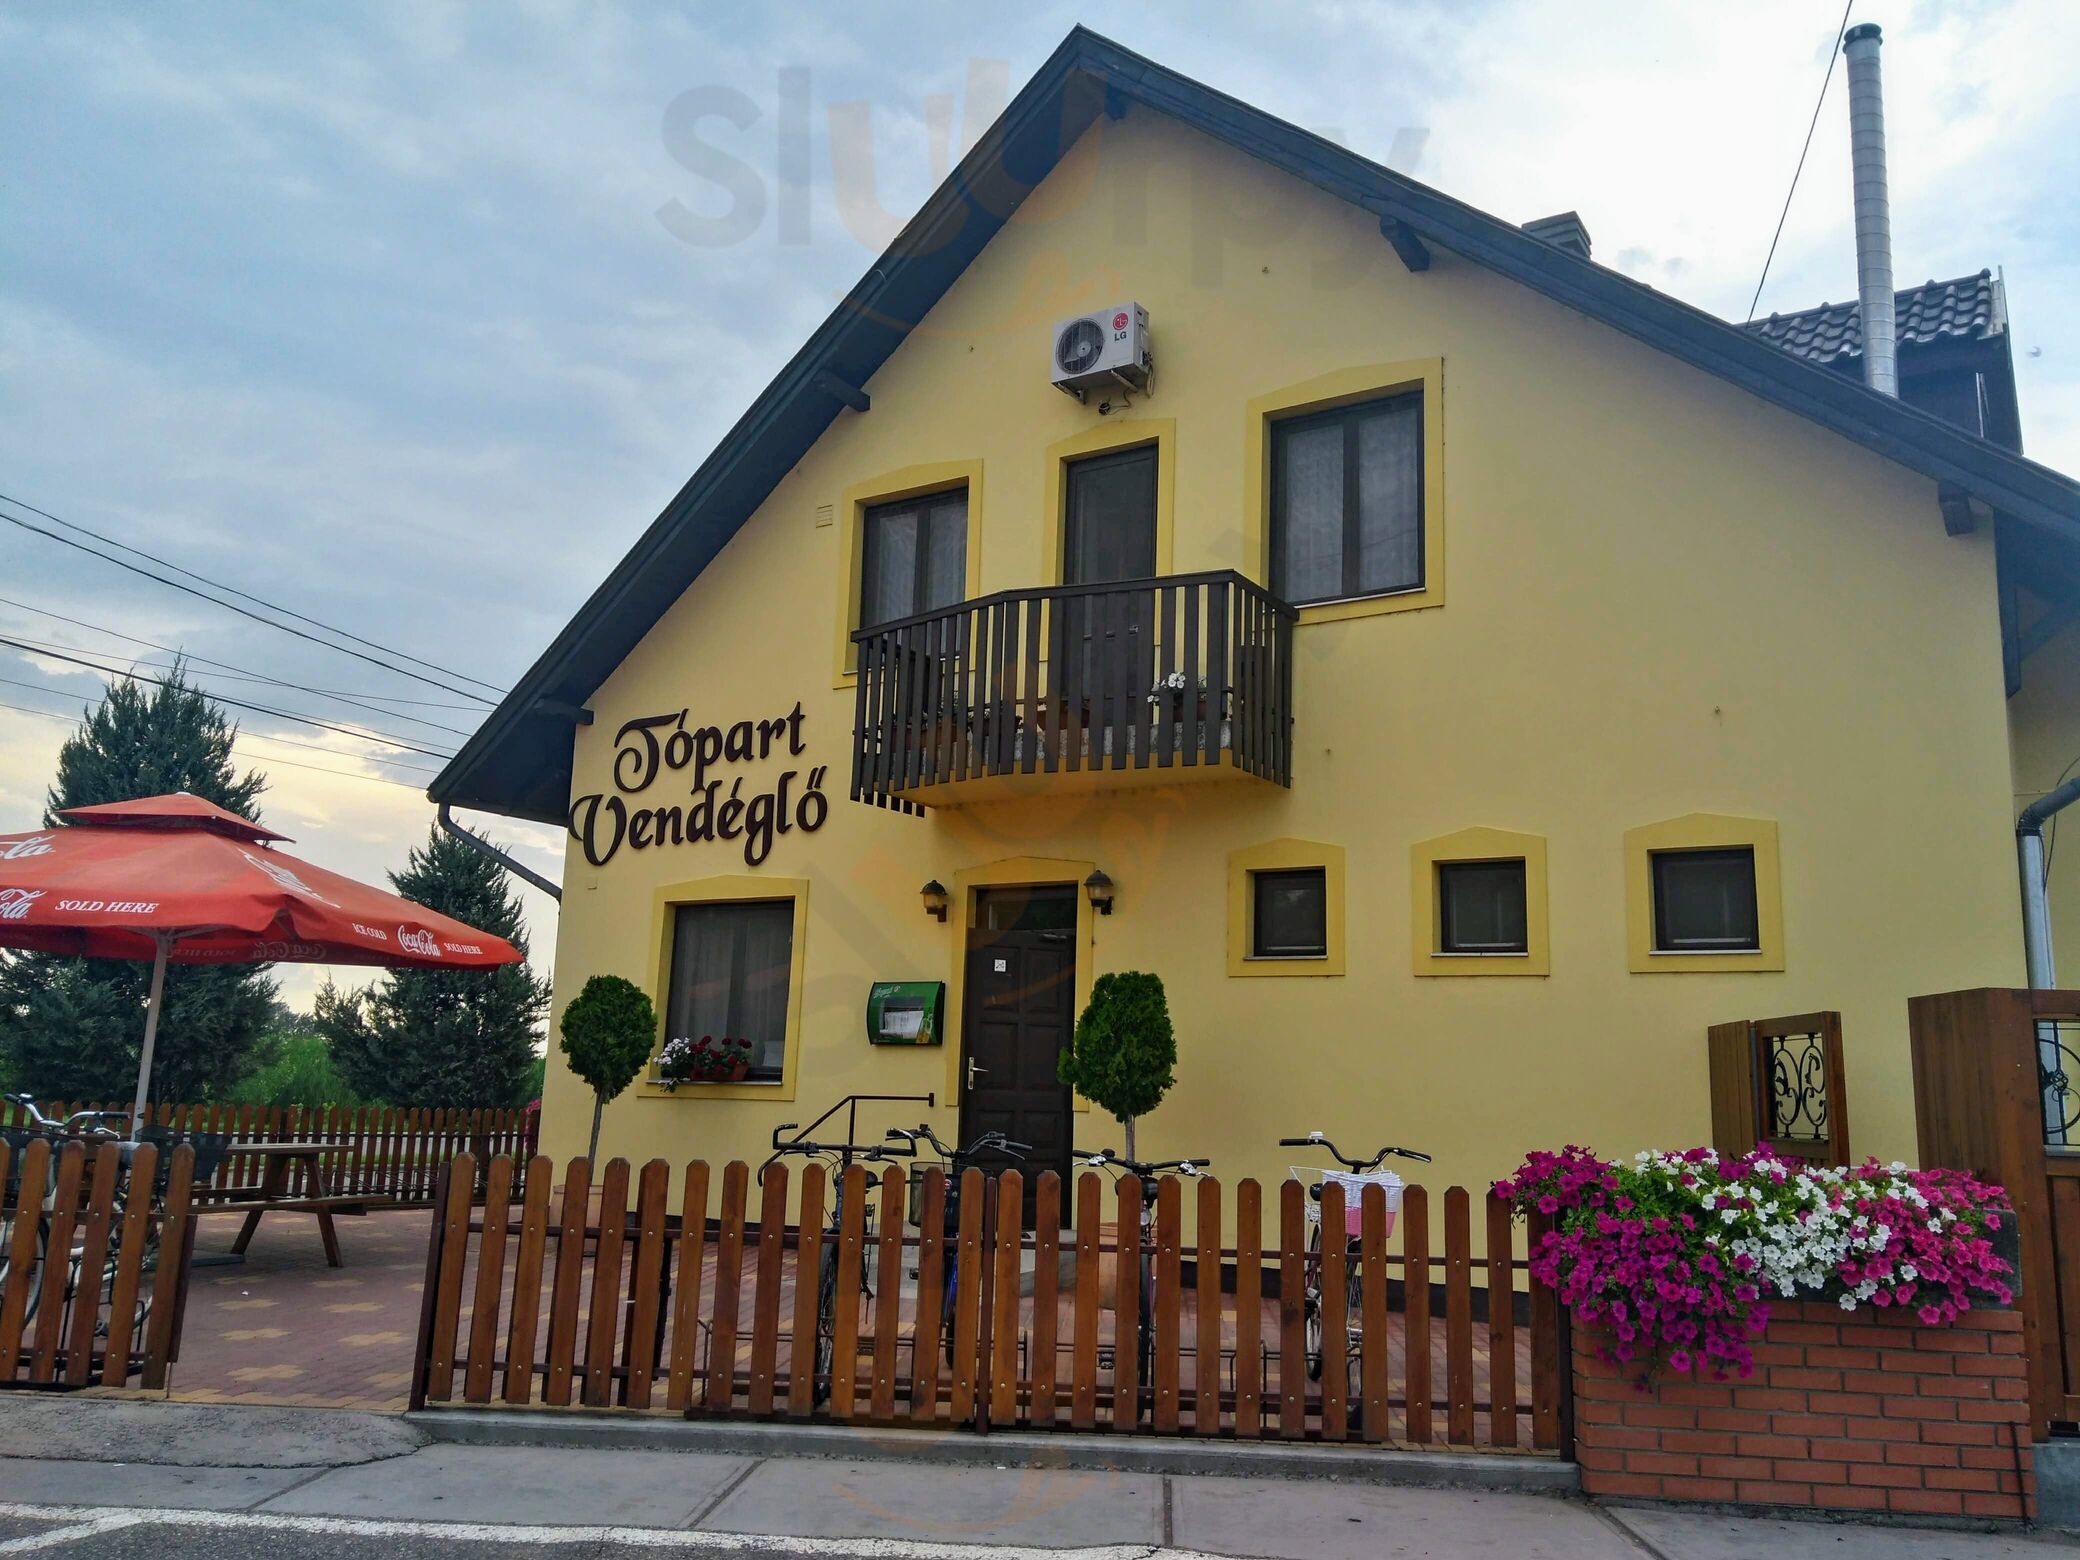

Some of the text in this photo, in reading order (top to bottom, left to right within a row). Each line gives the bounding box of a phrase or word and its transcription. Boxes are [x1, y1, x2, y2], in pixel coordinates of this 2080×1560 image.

[1114, 331, 1127, 341] LG
[613, 701, 806, 795] Tópart
[569, 765, 828, 867] Vendéglő
[54, 900, 104, 911] SOLD
[104, 902, 160, 914] HERE
[352, 922, 368, 936] ICE
[366, 927, 387, 940] COLD
[443, 942, 462, 953] SOLD
[461, 944, 483, 955] HERE
